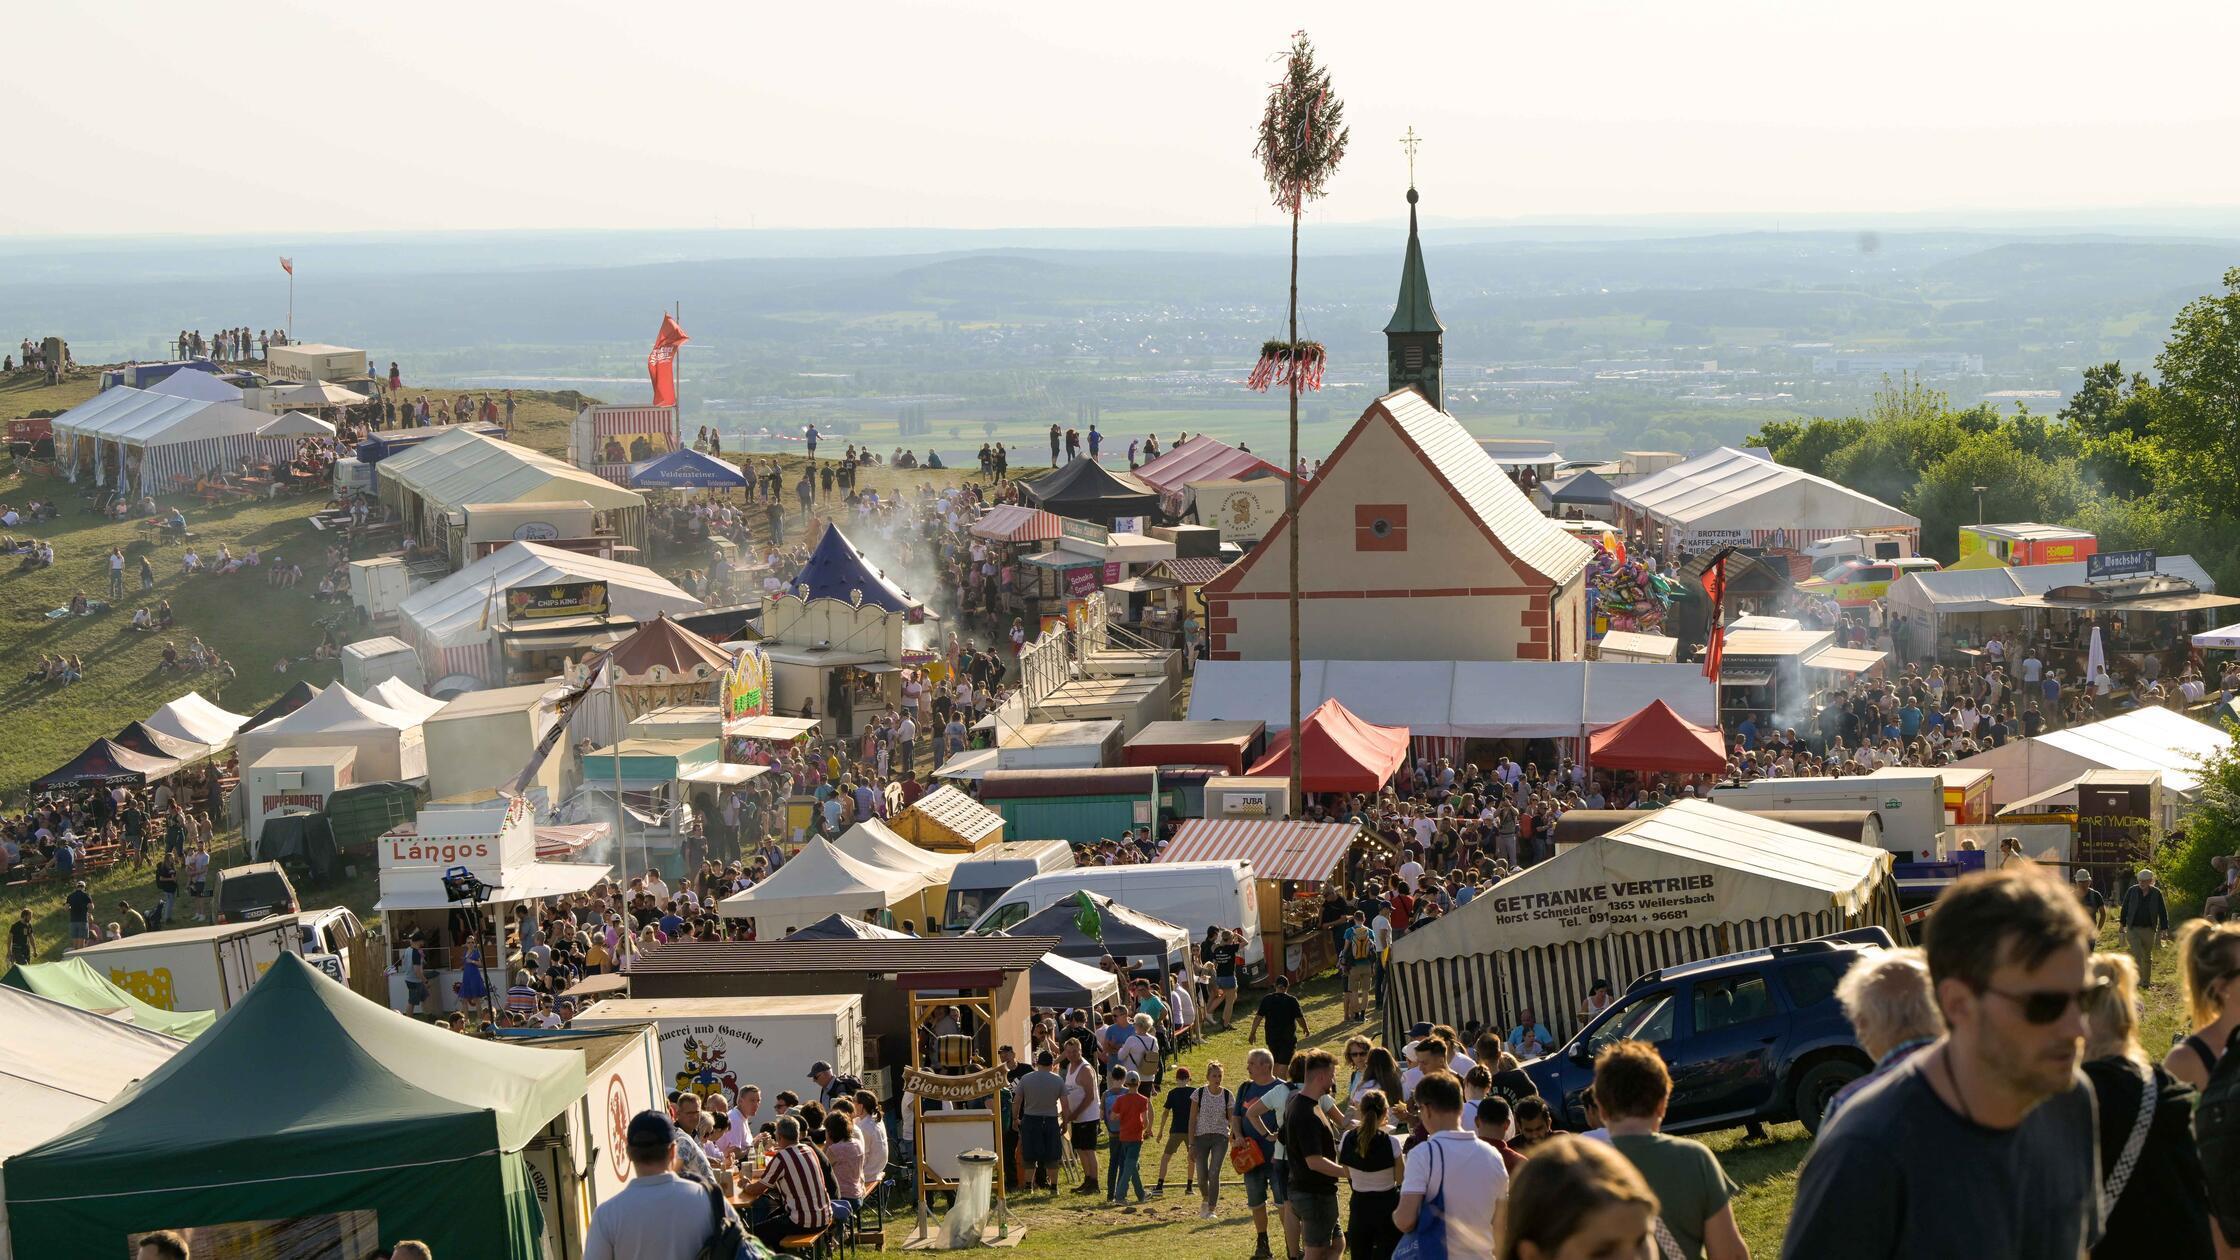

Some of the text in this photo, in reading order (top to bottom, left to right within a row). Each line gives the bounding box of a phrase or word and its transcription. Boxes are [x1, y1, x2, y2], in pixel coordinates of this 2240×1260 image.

[1688, 538, 1715, 546] KAFFEE
[537, 598, 577, 607] CHIPS KING
[262, 794, 324, 816] HUPPENDORFER
[1494, 874, 1714, 913] GETRÄNKE VERTRIEB
[1496, 912, 1529, 925] Horst
[1533, 904, 1594, 921] Schneider
[1639, 893, 1715, 909] Weilersbach
[1558, 916, 1582, 928] Tel.
[1652, 910, 1688, 921] 96681
[694, 1025, 714, 1034] und
[718, 1024, 764, 1048] Gasthof
[907, 1070, 1004, 1096] Bier vom Faß
